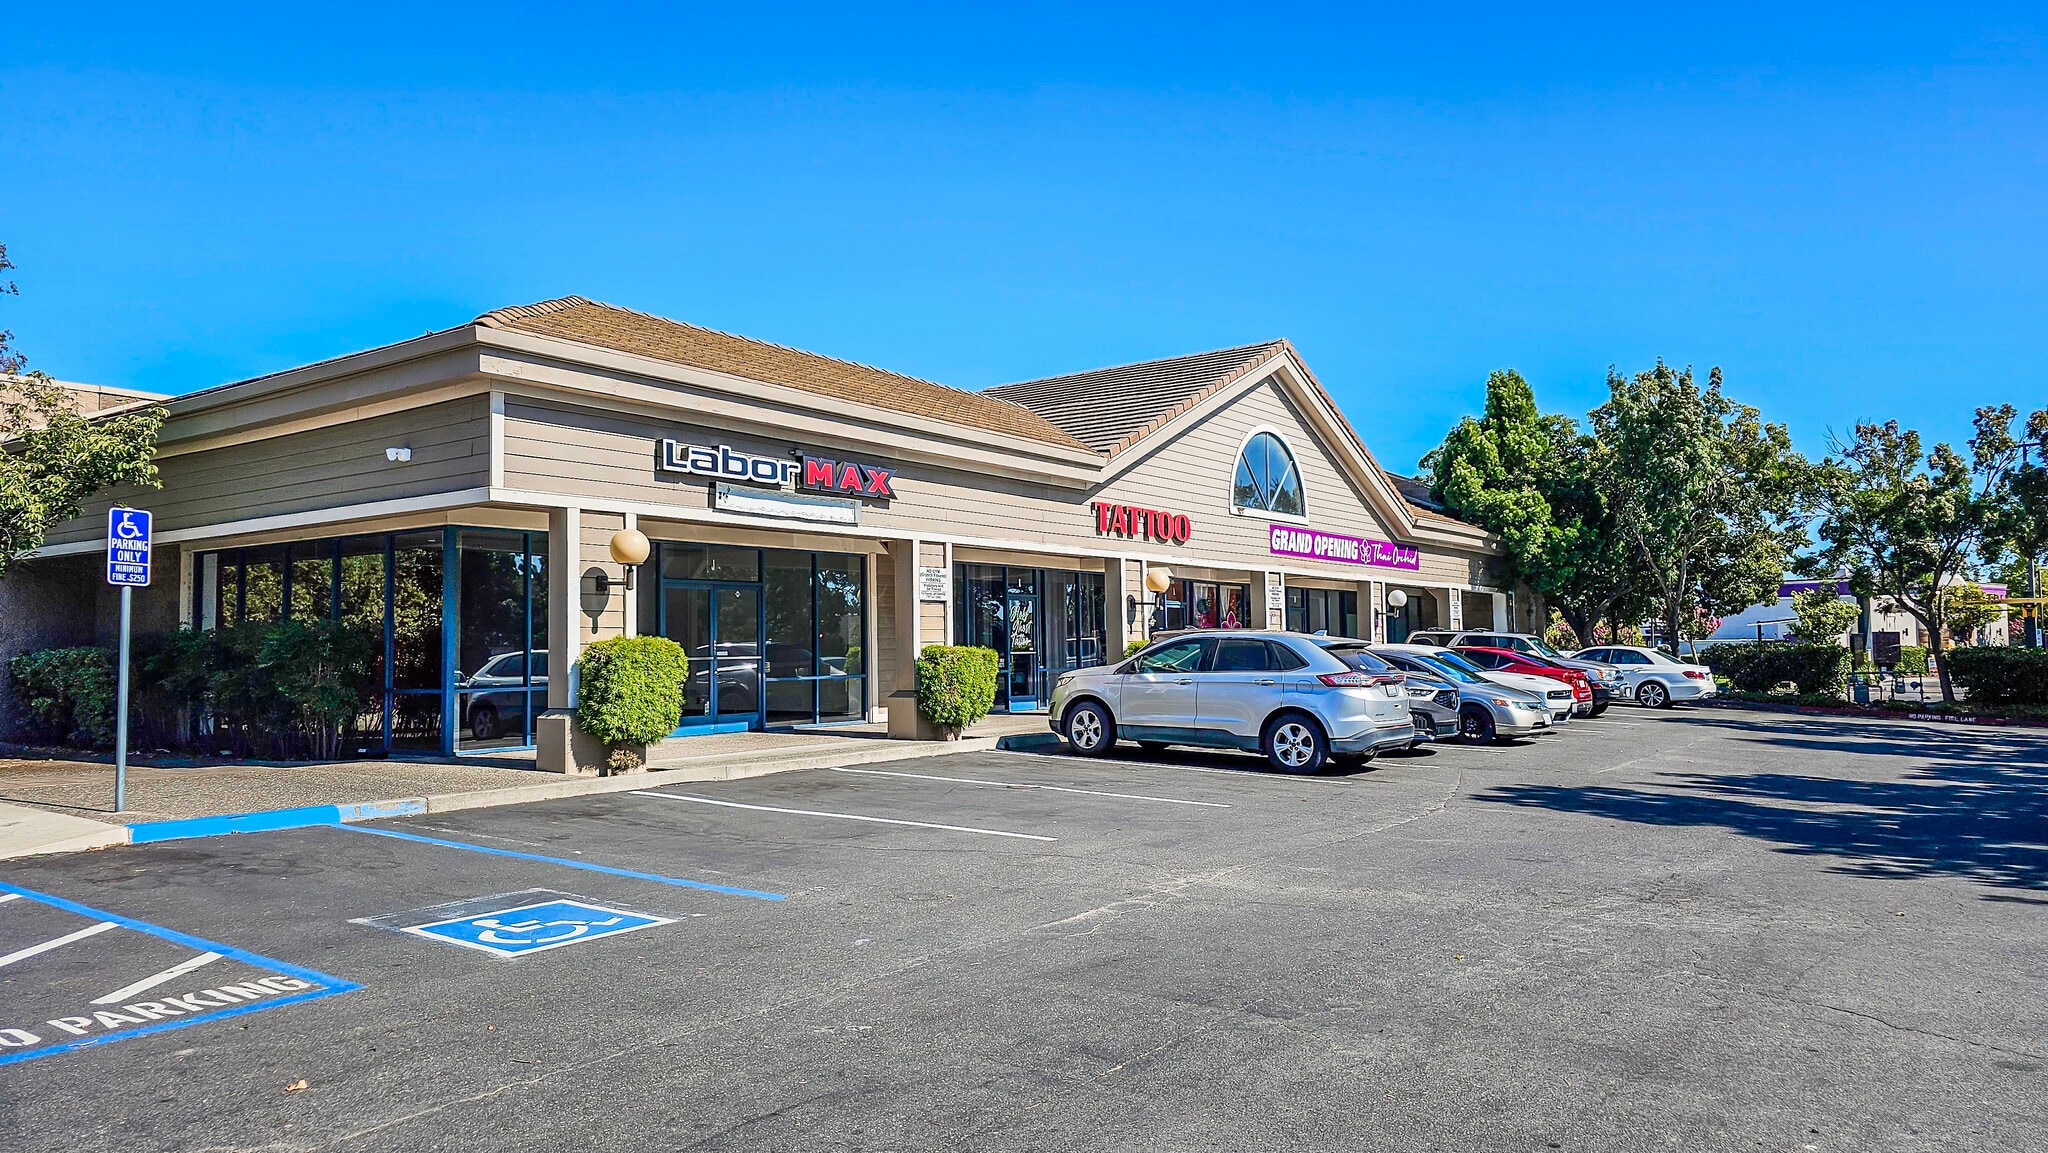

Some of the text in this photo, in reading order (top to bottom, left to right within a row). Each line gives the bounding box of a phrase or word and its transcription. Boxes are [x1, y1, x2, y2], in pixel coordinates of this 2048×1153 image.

[1094, 501, 1191, 543] TATTOO
[111, 538, 148, 551] PARKING
[1271, 528, 1359, 560] GRAND OPENING
[117, 550, 142, 562] ONLY
[1371, 543, 1418, 566] Thai Orchid
[112, 572, 146, 582] FINE $250
[115, 564, 143, 574] MINIMUM
[0, 976, 313, 1047] O PARKING
